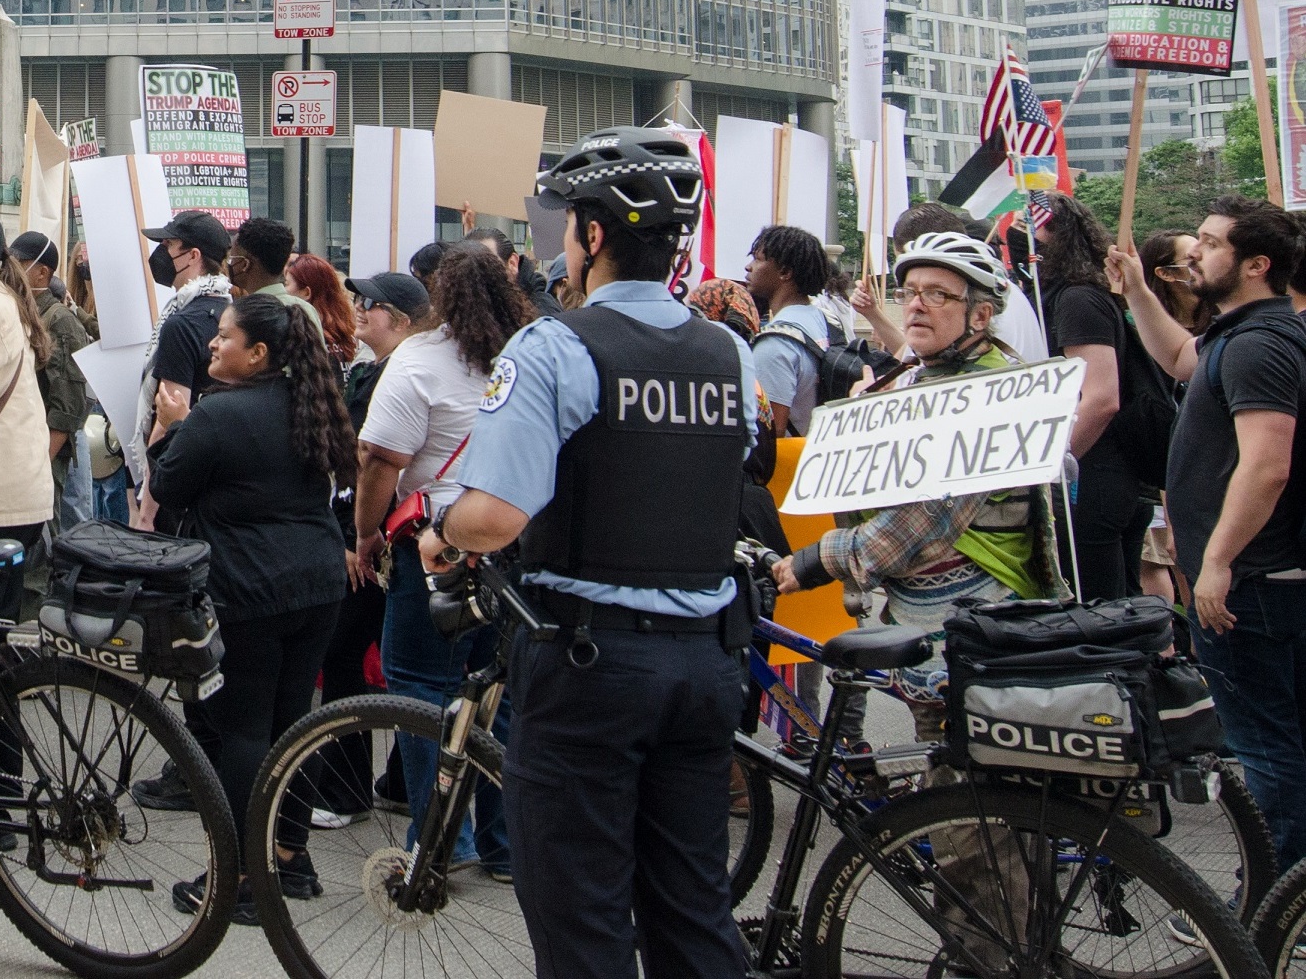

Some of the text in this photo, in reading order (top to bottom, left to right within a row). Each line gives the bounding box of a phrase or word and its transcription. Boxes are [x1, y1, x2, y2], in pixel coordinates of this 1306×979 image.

[1169, 8, 1231, 24] RIGHTS TO
[278, 28, 329, 37] TOW ZONE
[1148, 21, 1157, 31] &
[1168, 20, 1231, 38] STRIKE
[1130, 34, 1228, 53] EDUCATION &
[1147, 46, 1228, 66] FREEDOM
[147, 72, 237, 98] STOP THE
[147, 96, 240, 113] TRUMP AGENDA!
[299, 103, 321, 113] BUS
[147, 112, 242, 123] DEFEND & EXPAND
[299, 114, 326, 123] STOP
[77, 121, 94, 143] THE
[148, 121, 243, 133] IMMIGRANT RIGHTS
[276, 126, 329, 135] TOW ZONE
[150, 133, 243, 143] STAND WITH PALESTINE
[581, 138, 620, 151] POLICE
[150, 142, 244, 153] END US AID TO ISRAEL
[184, 154, 246, 165] POLICE CRIMES
[194, 167, 247, 177] LGBTQIA+ AND
[223, 177, 248, 188] RIGHTS
[221, 188, 242, 198] RIGHTS
[212, 198, 249, 207] & STRIKE
[618, 377, 738, 426] POLICE
[814, 365, 1079, 444] IMMIGRANTS TODAY
[794, 416, 1067, 501] CITIZENS NEXT
[42, 627, 138, 671] POLICE
[966, 714, 1125, 761] POLICE
[821, 829, 894, 928] BONTRAER
